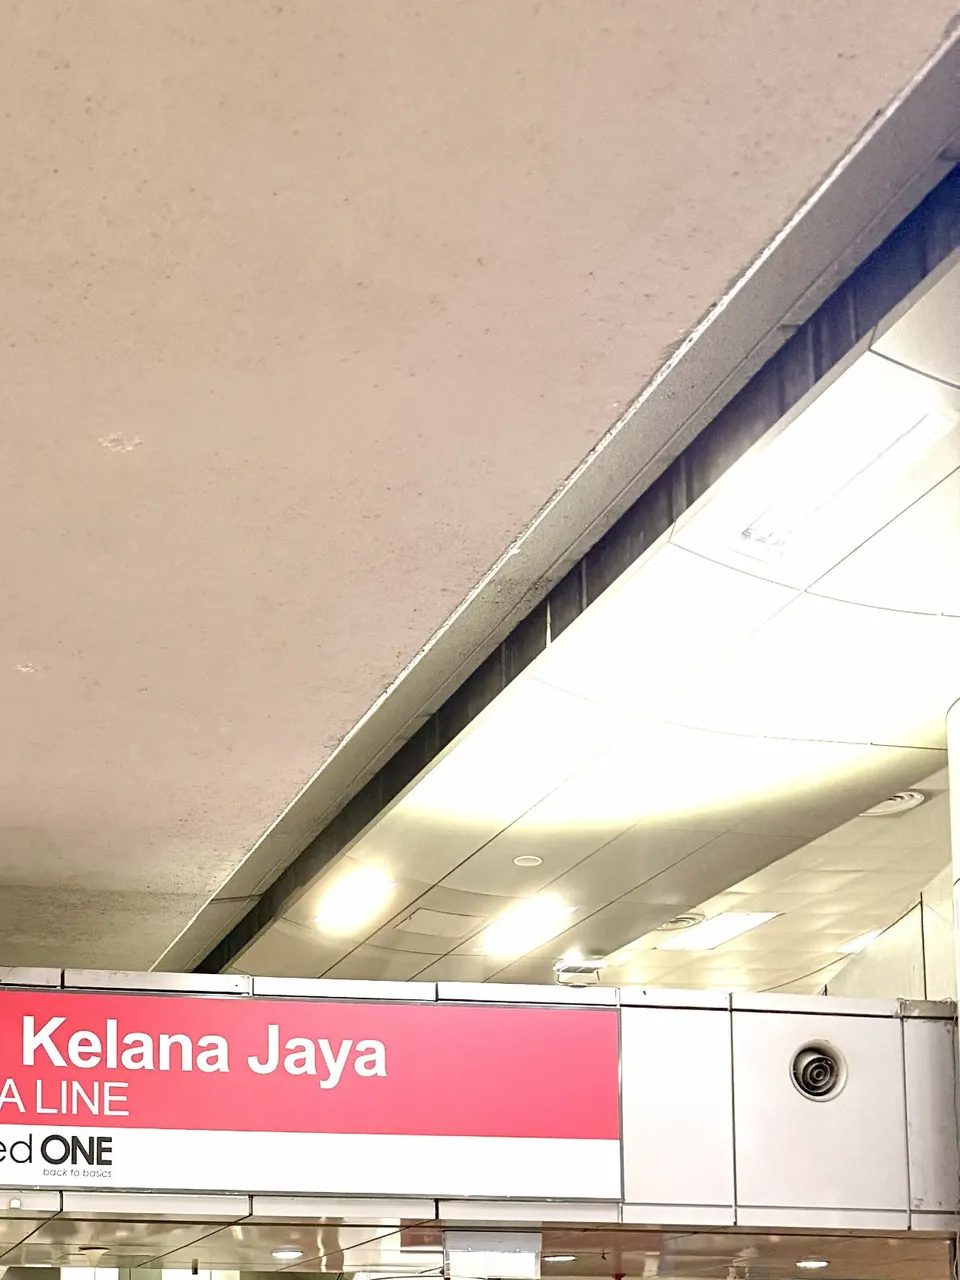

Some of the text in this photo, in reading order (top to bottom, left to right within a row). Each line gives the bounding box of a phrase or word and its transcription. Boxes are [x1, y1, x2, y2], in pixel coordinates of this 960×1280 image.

[22, 1015, 230, 1074] Kelana
[247, 1024, 389, 1089] Jaya
[35, 1079, 130, 1117] LINE
[42, 1167, 113, 1179] back to basics
